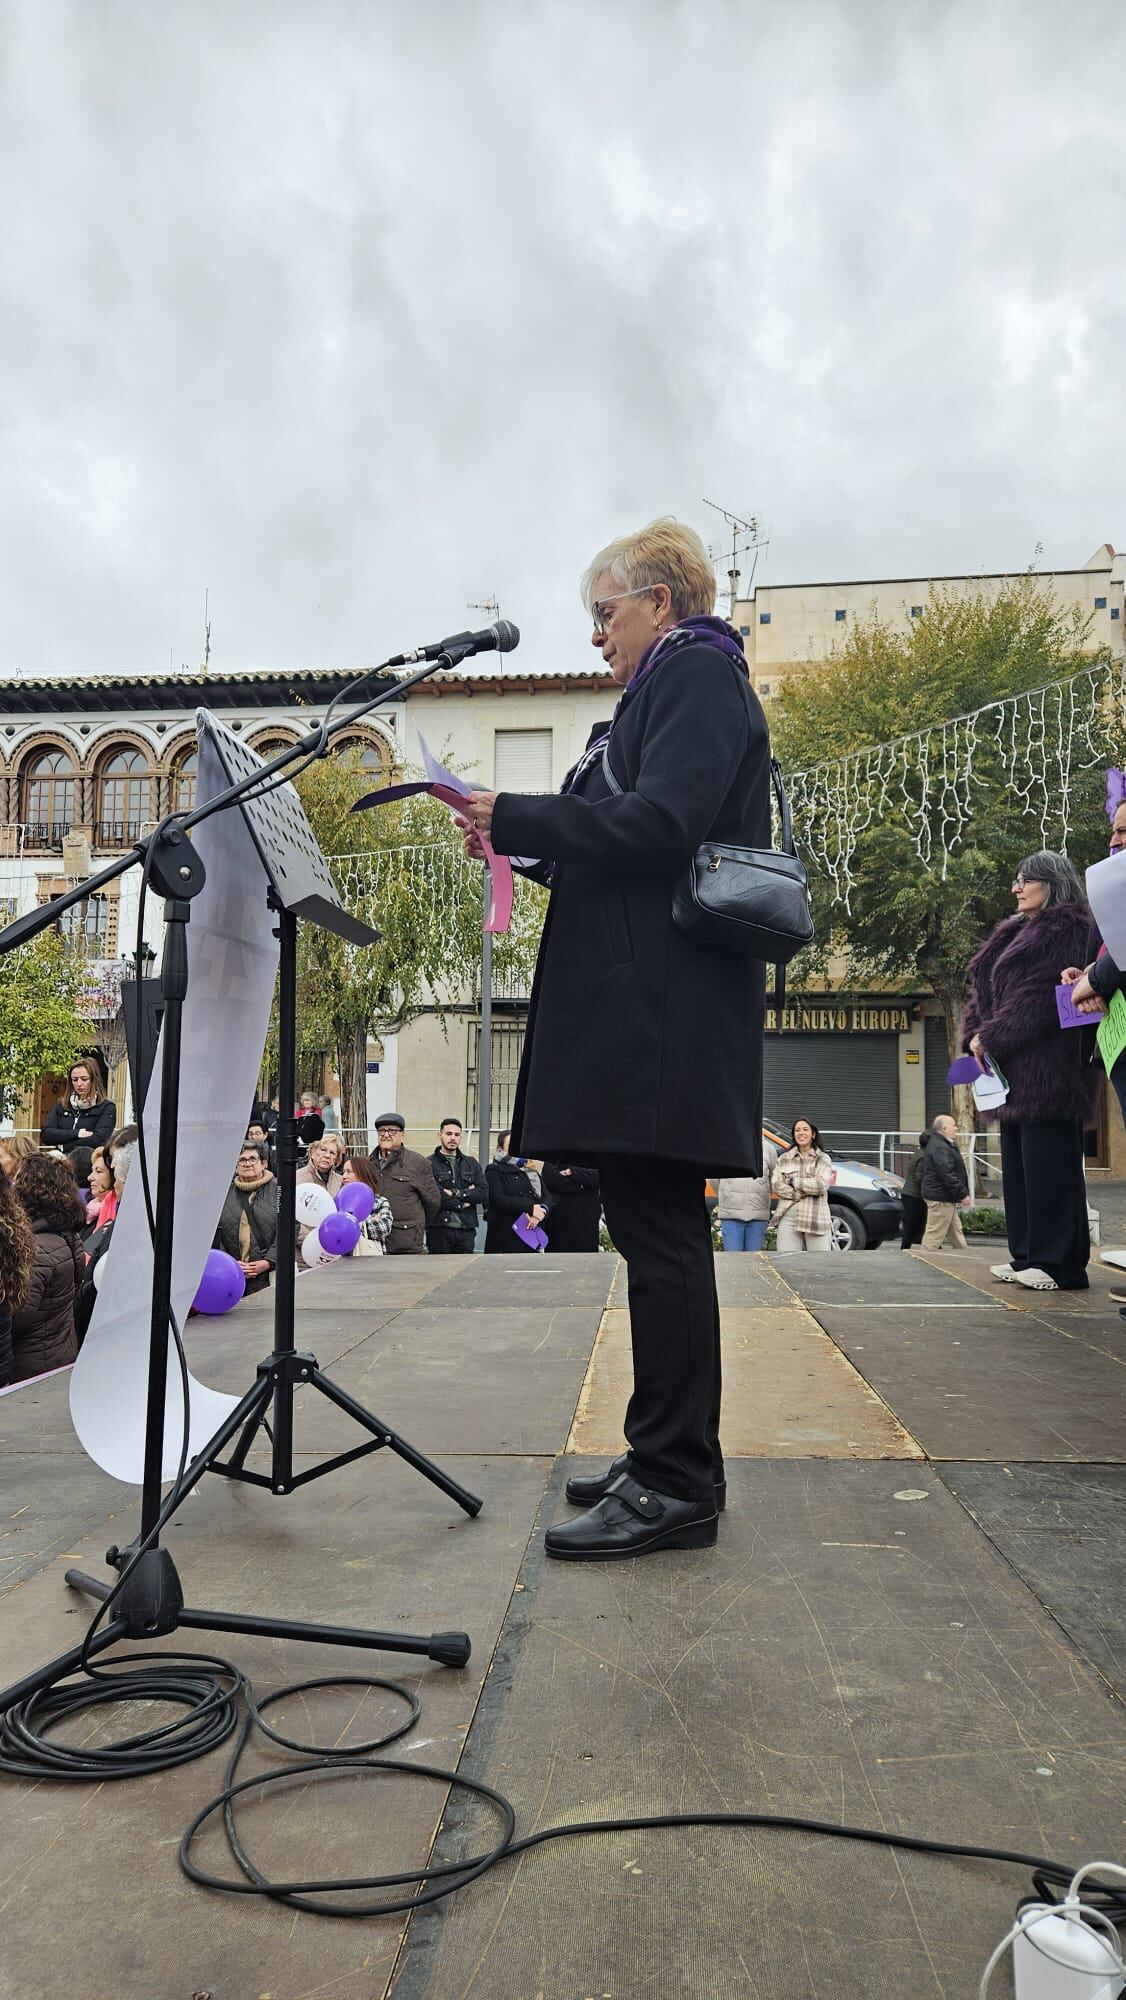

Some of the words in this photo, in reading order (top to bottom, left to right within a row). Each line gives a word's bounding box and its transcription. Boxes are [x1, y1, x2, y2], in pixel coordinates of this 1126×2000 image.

[764, 1010, 777, 1029] R
[781, 1010, 798, 1030] EL
[802, 1010, 848, 1030] NUEVO
[852, 1010, 910, 1031] EUROPA
